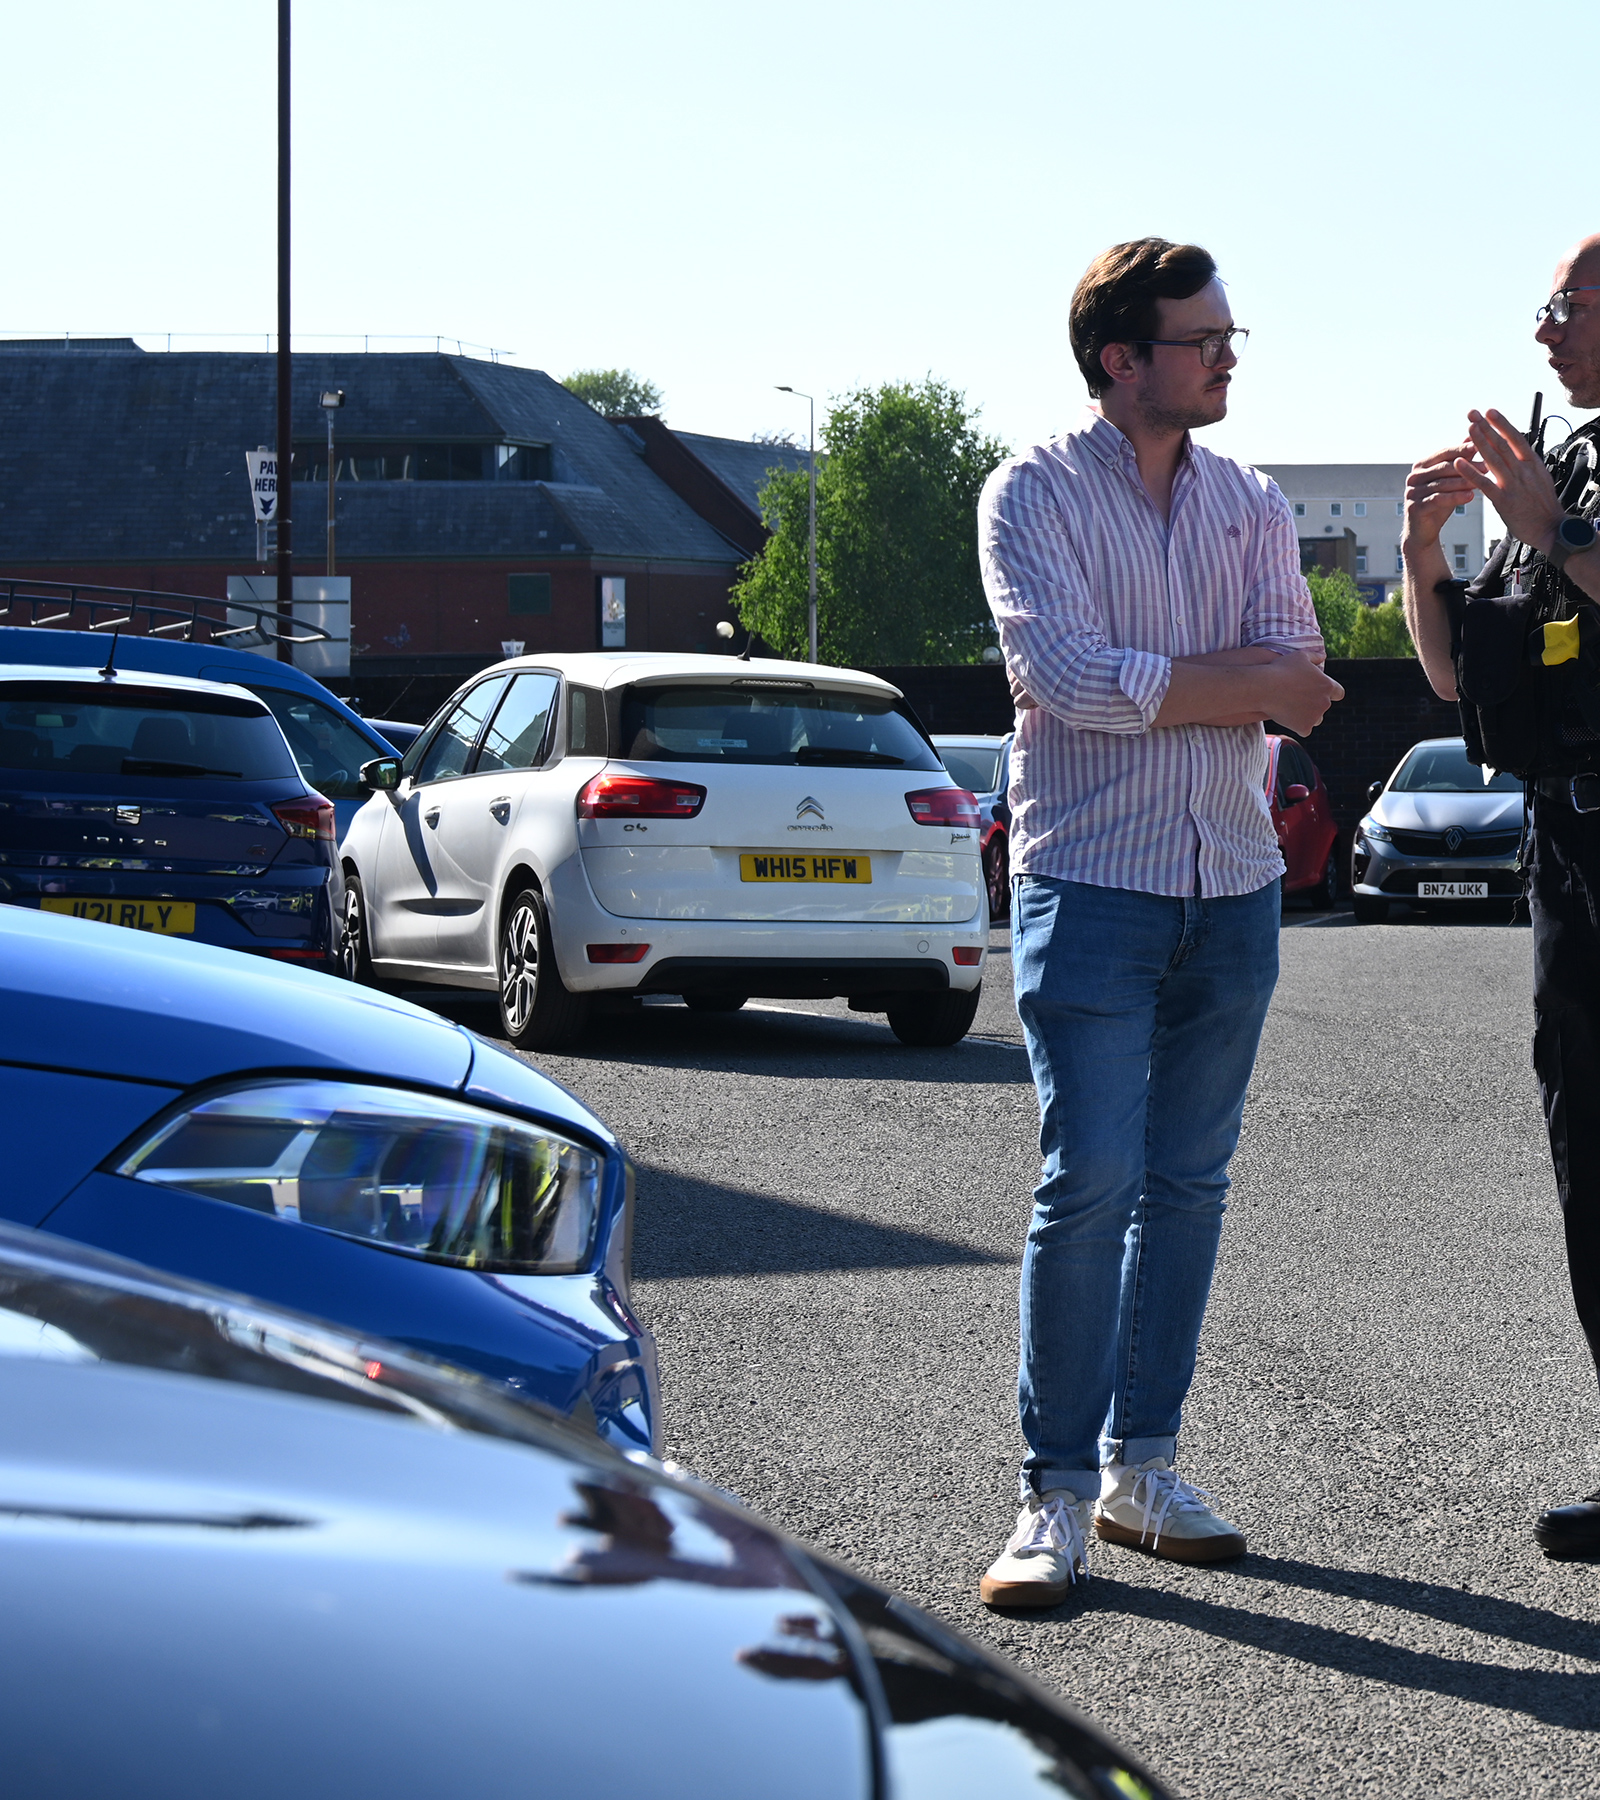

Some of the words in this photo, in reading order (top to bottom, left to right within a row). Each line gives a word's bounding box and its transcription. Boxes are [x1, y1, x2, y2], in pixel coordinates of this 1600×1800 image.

[254, 478, 278, 492] HER
[753, 857, 807, 878] WH15
[812, 858, 857, 879] HFW
[1423, 884, 1455, 896] BN74
[1458, 884, 1483, 896] UKK
[119, 904, 172, 931] RLY
